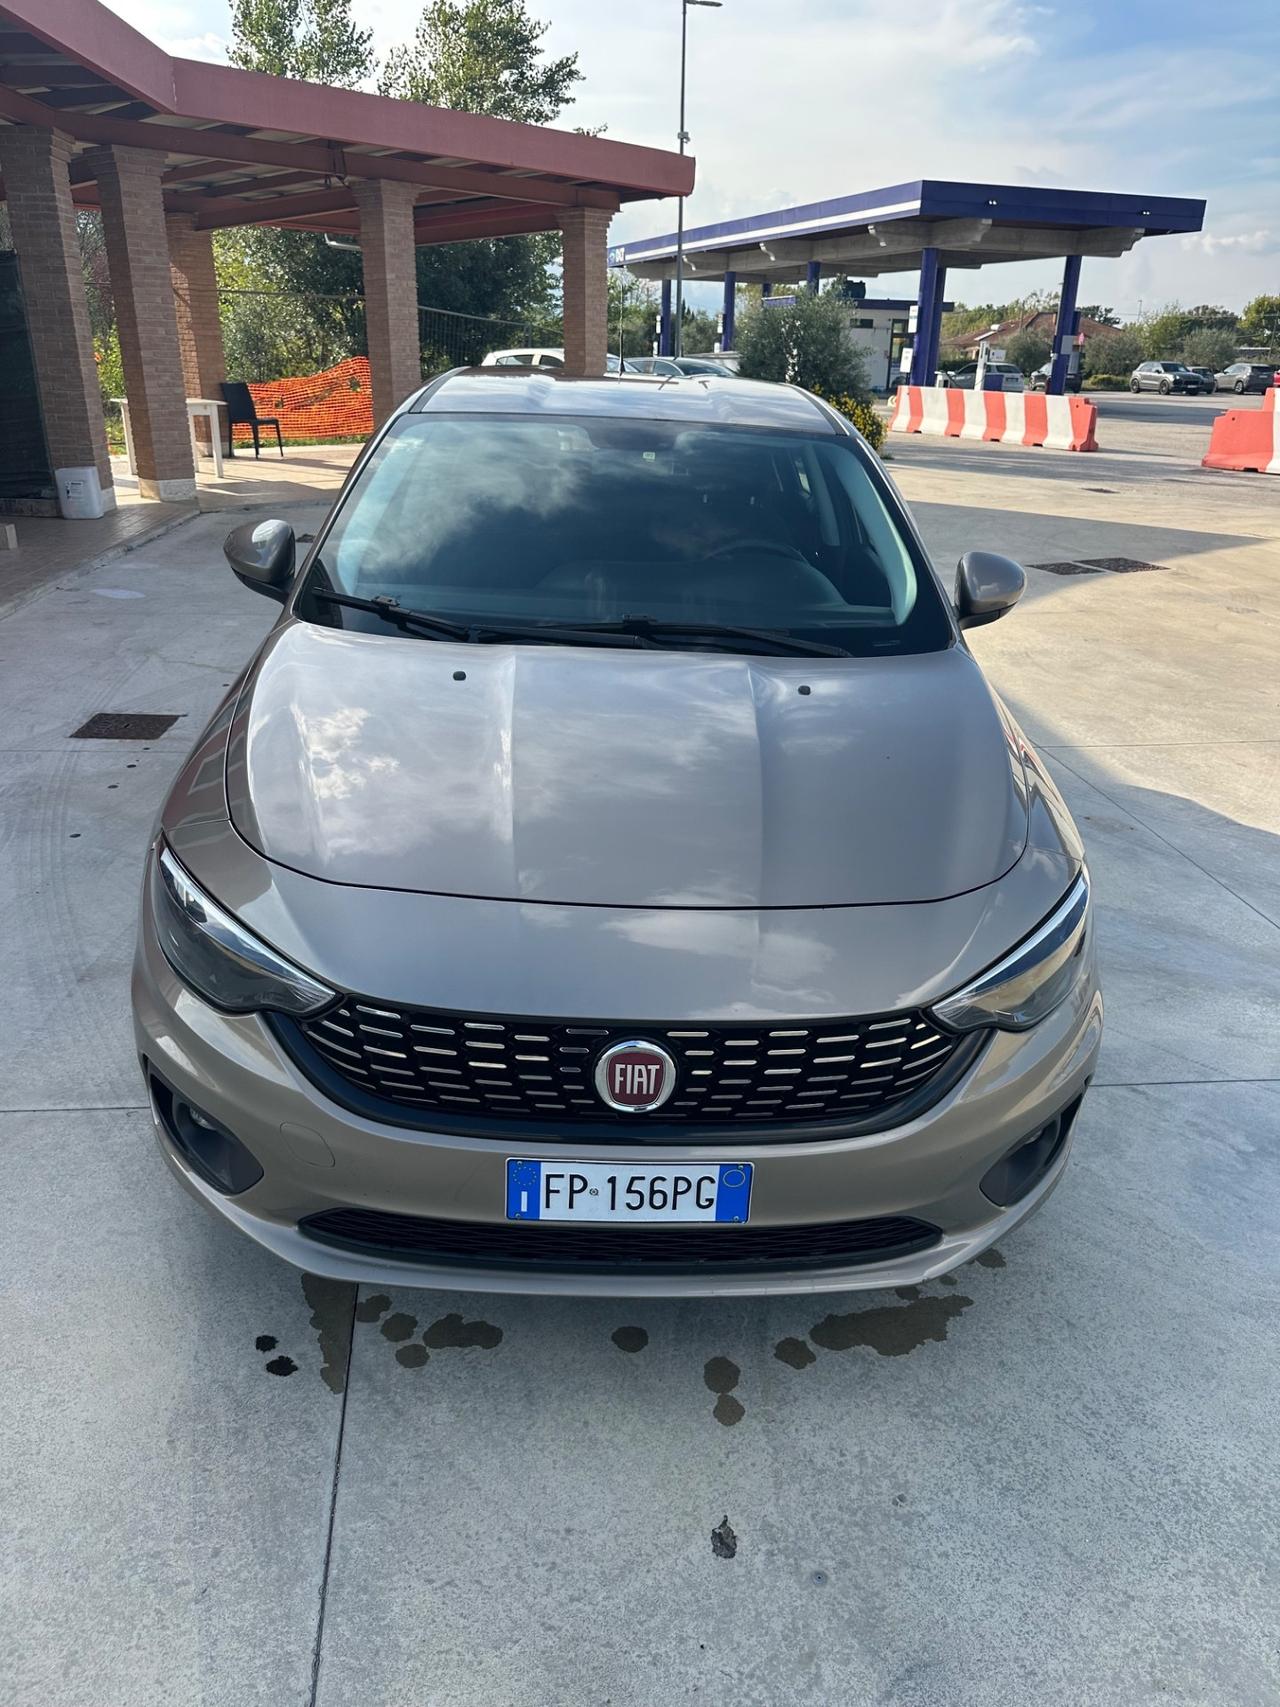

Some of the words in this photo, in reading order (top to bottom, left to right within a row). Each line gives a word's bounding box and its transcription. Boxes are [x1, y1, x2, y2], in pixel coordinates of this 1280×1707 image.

[614, 1063, 660, 1095] FIAT
[545, 1173, 588, 1210] FP
[607, 1175, 717, 1211] 156PG
